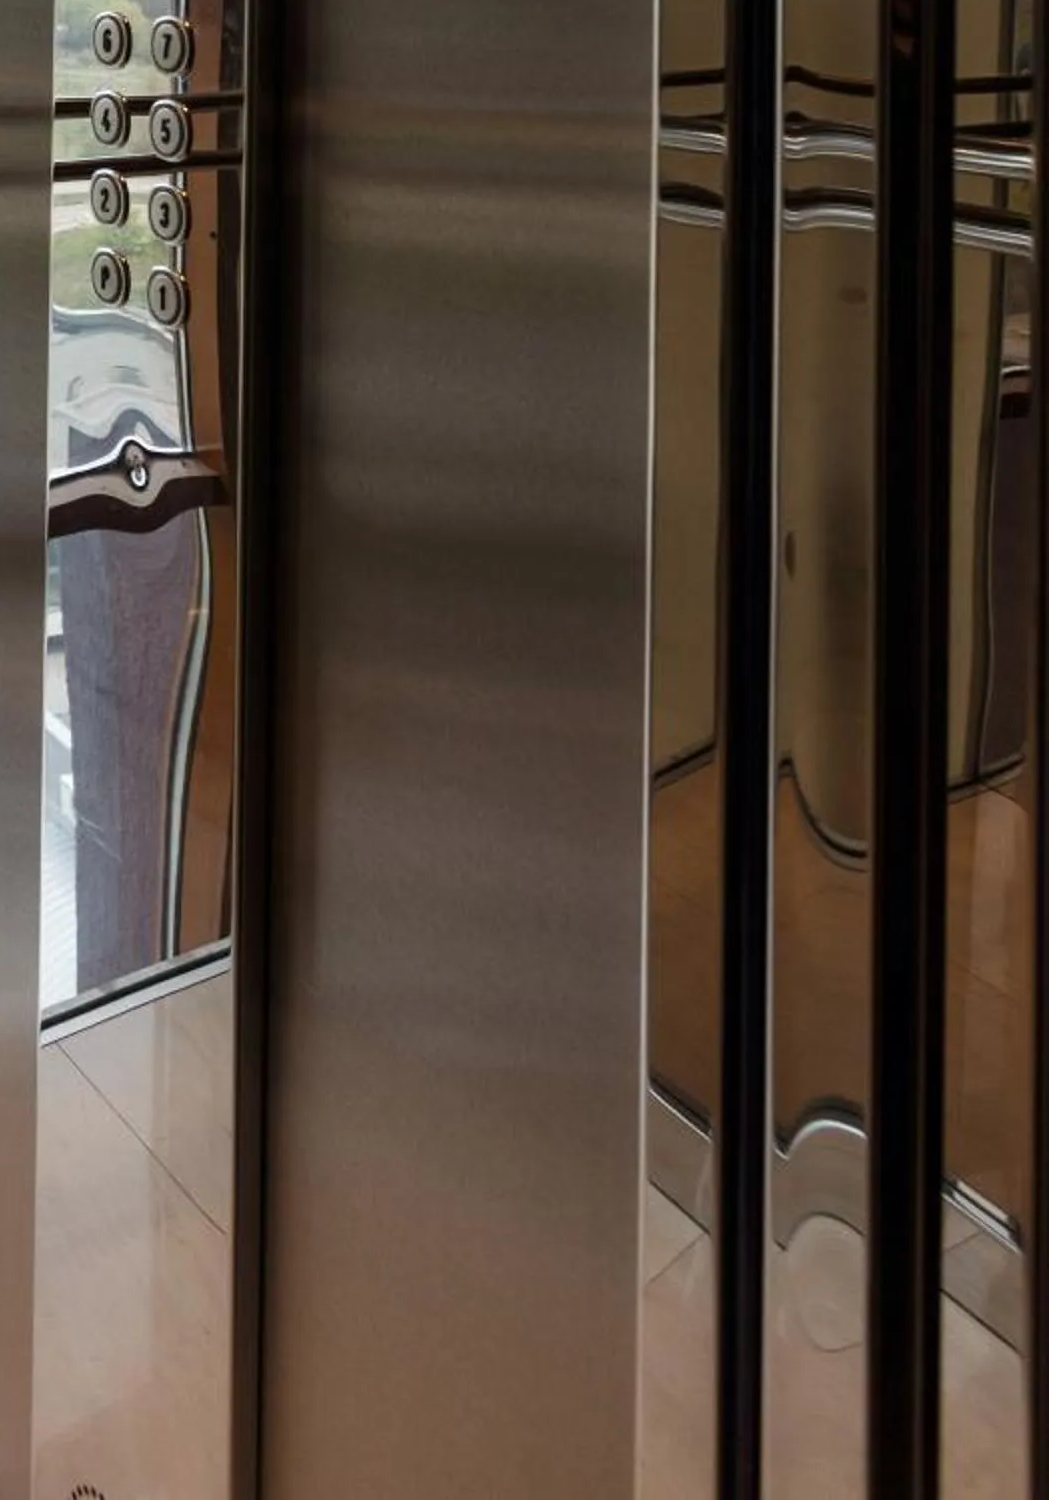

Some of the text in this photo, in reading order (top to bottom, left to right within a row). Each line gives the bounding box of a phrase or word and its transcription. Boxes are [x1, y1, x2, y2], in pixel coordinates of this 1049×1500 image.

[101, 28, 113, 53] 6
[161, 32, 173, 61] 7
[100, 107, 111, 133] 4
[159, 118, 172, 145] 5
[99, 186, 110, 213] 2
[158, 201, 171, 229] 3
[158, 284, 167, 312] 1
